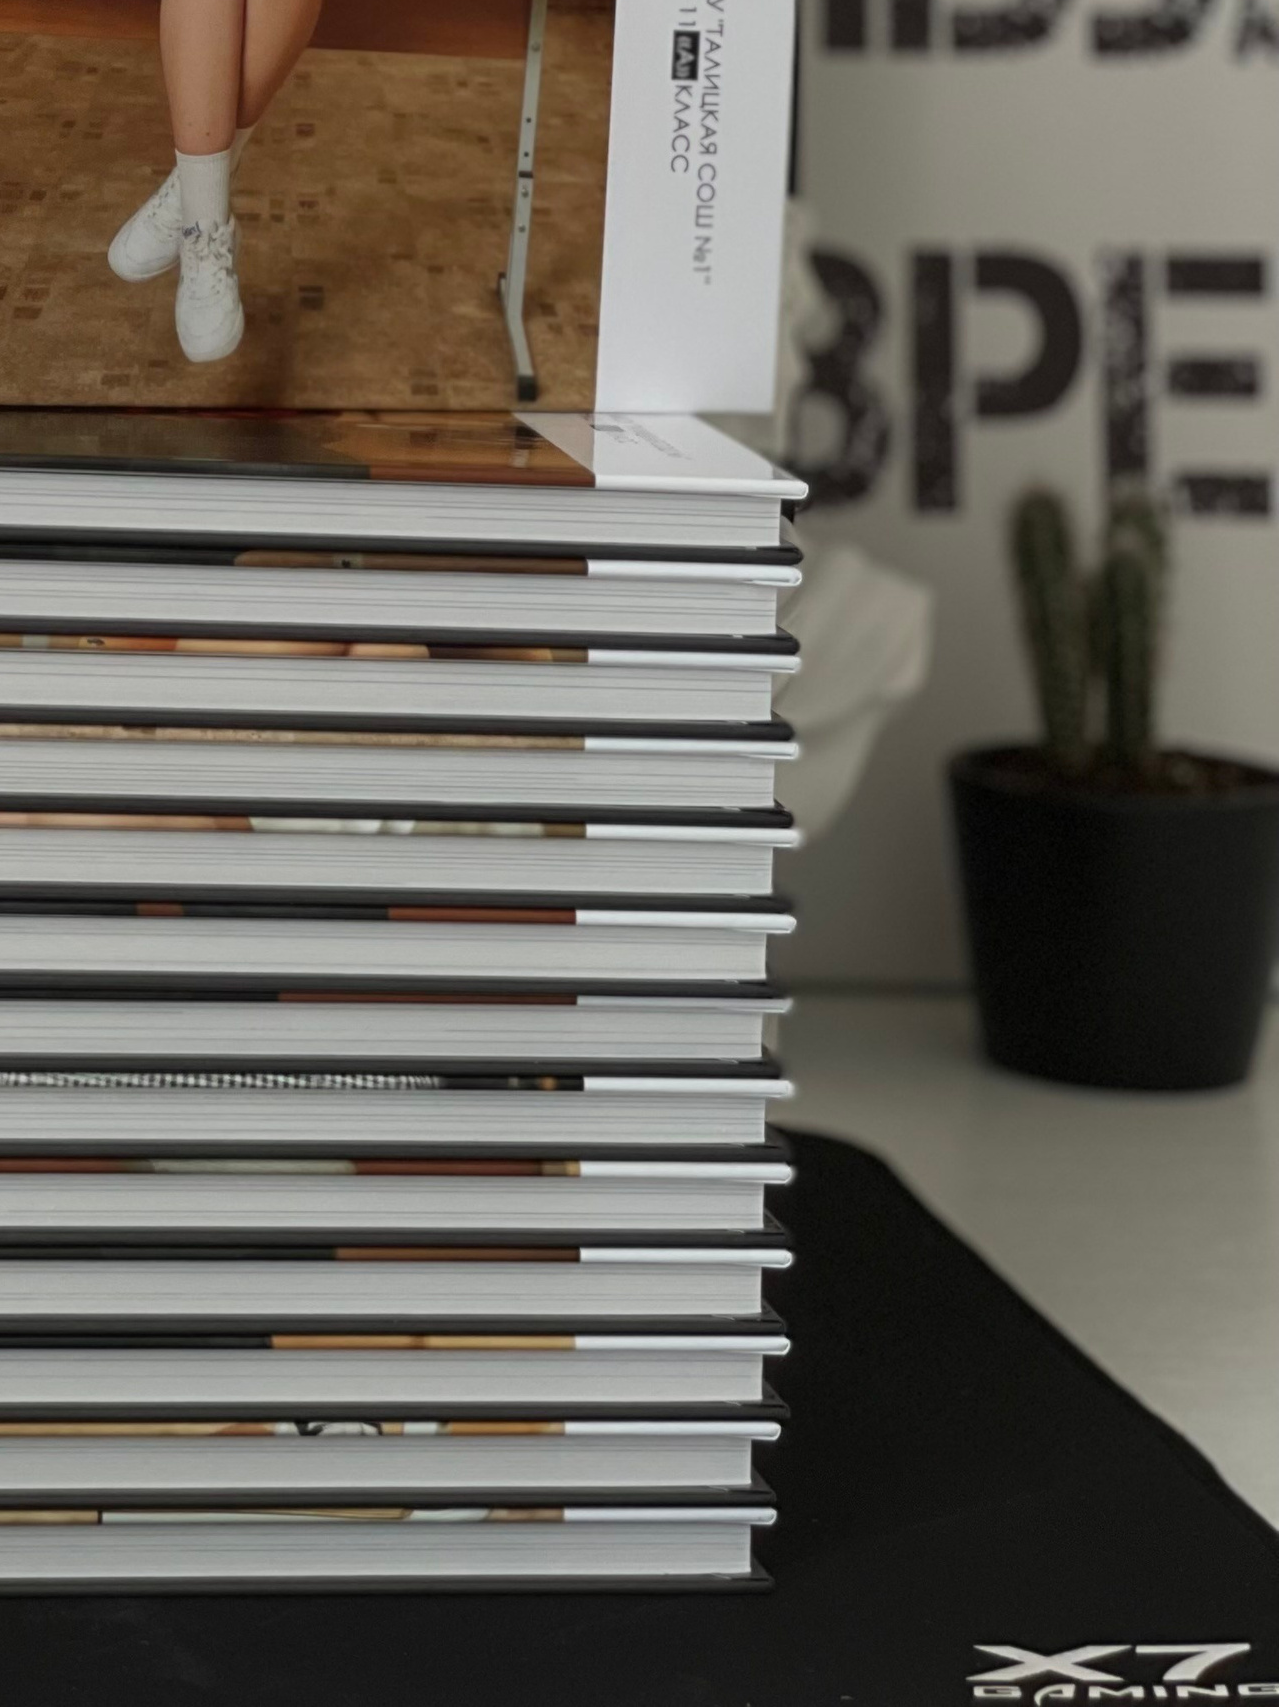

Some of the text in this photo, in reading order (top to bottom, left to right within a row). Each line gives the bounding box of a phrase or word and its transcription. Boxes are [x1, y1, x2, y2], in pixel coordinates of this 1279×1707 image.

[678, 6, 697, 26] 11
[670, 84, 693, 173] КЛАСС
[694, 163, 717, 228] СОШ
[966, 1643, 1250, 1681] X7
[973, 1683, 1279, 1707] GAMING
